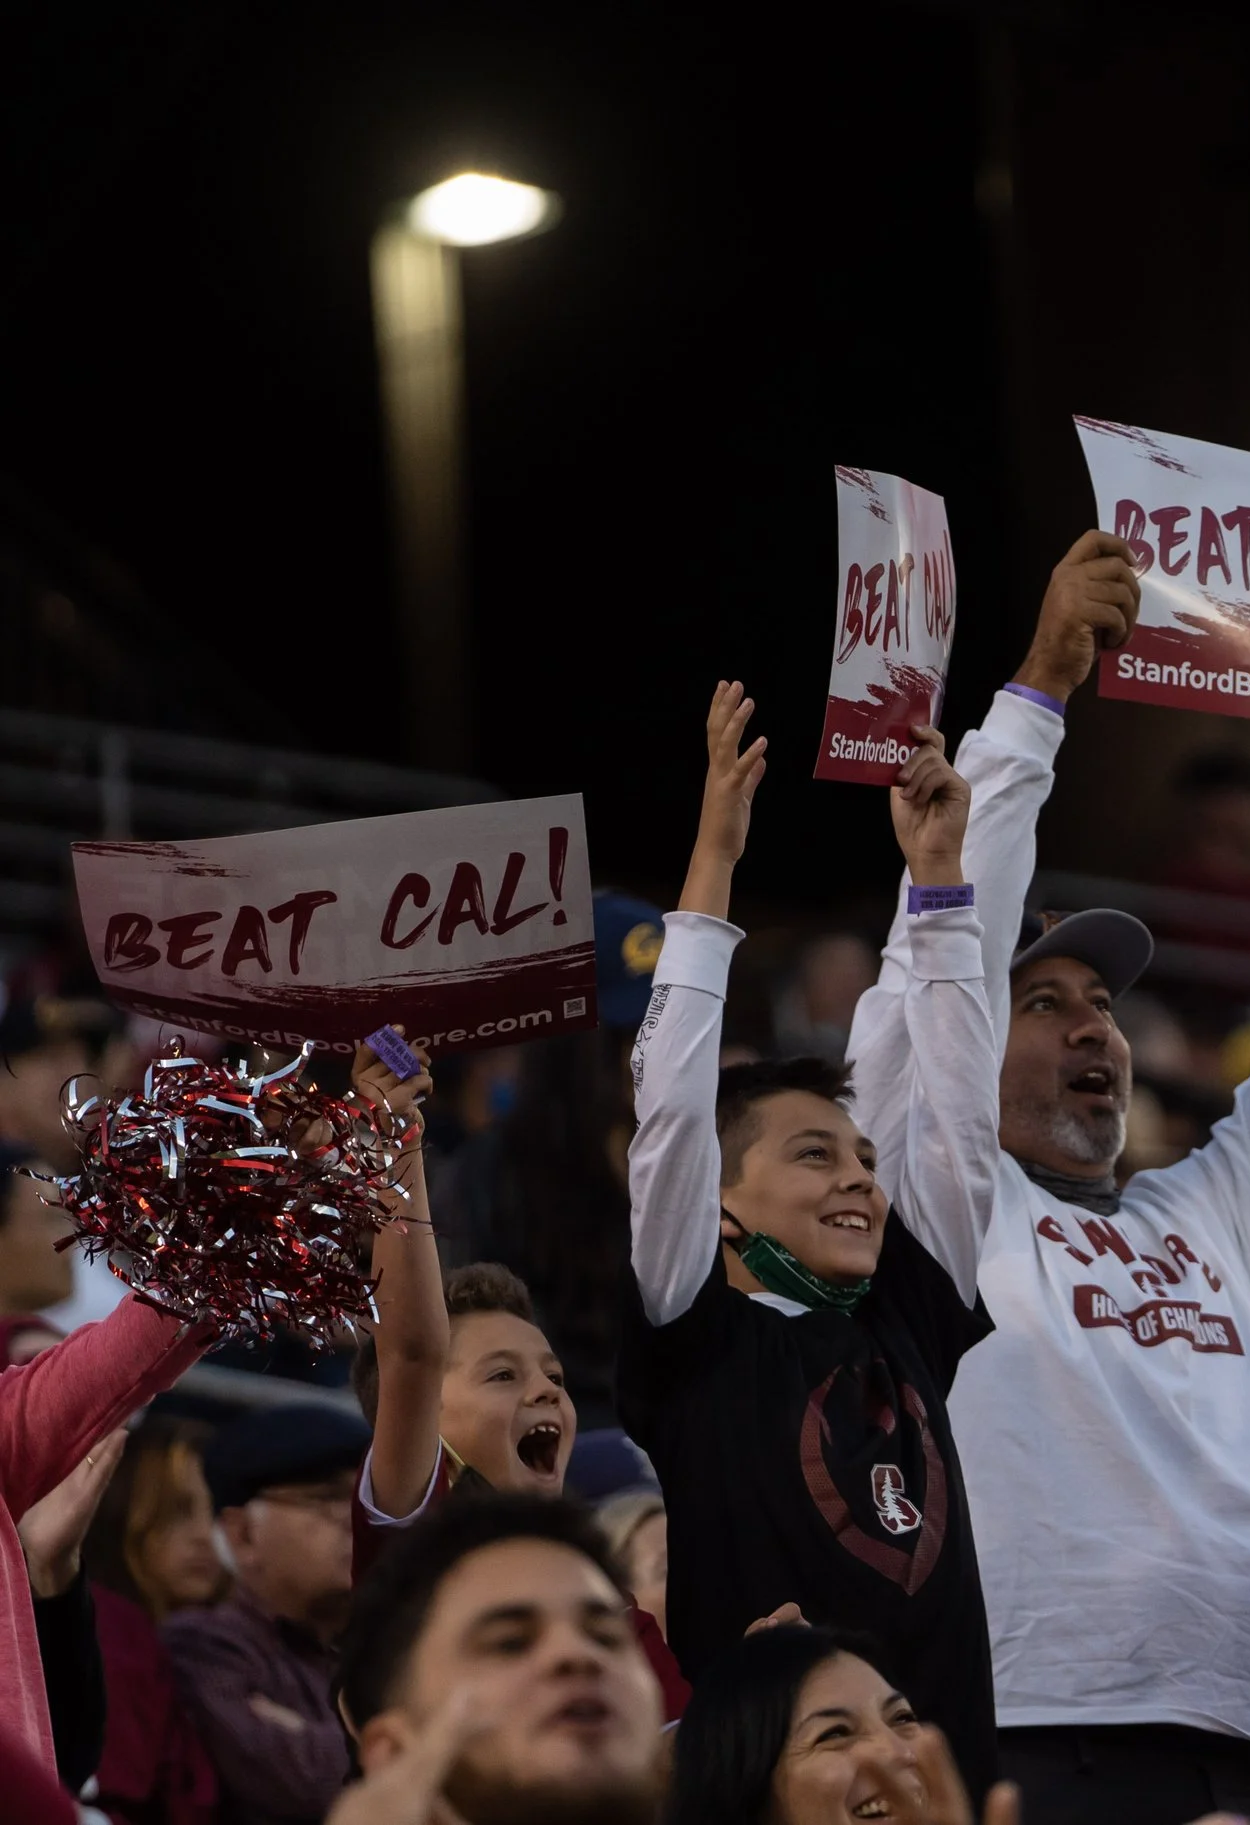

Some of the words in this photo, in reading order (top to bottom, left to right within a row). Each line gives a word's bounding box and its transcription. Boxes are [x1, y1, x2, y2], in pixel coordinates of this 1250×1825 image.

[835, 552, 915, 665] BEAT
[102, 889, 338, 976] BEAT
[380, 826, 569, 951] CAL!
[133, 1002, 553, 1058] StanfordBooore.com
[1136, 1310, 1159, 1341] OF
